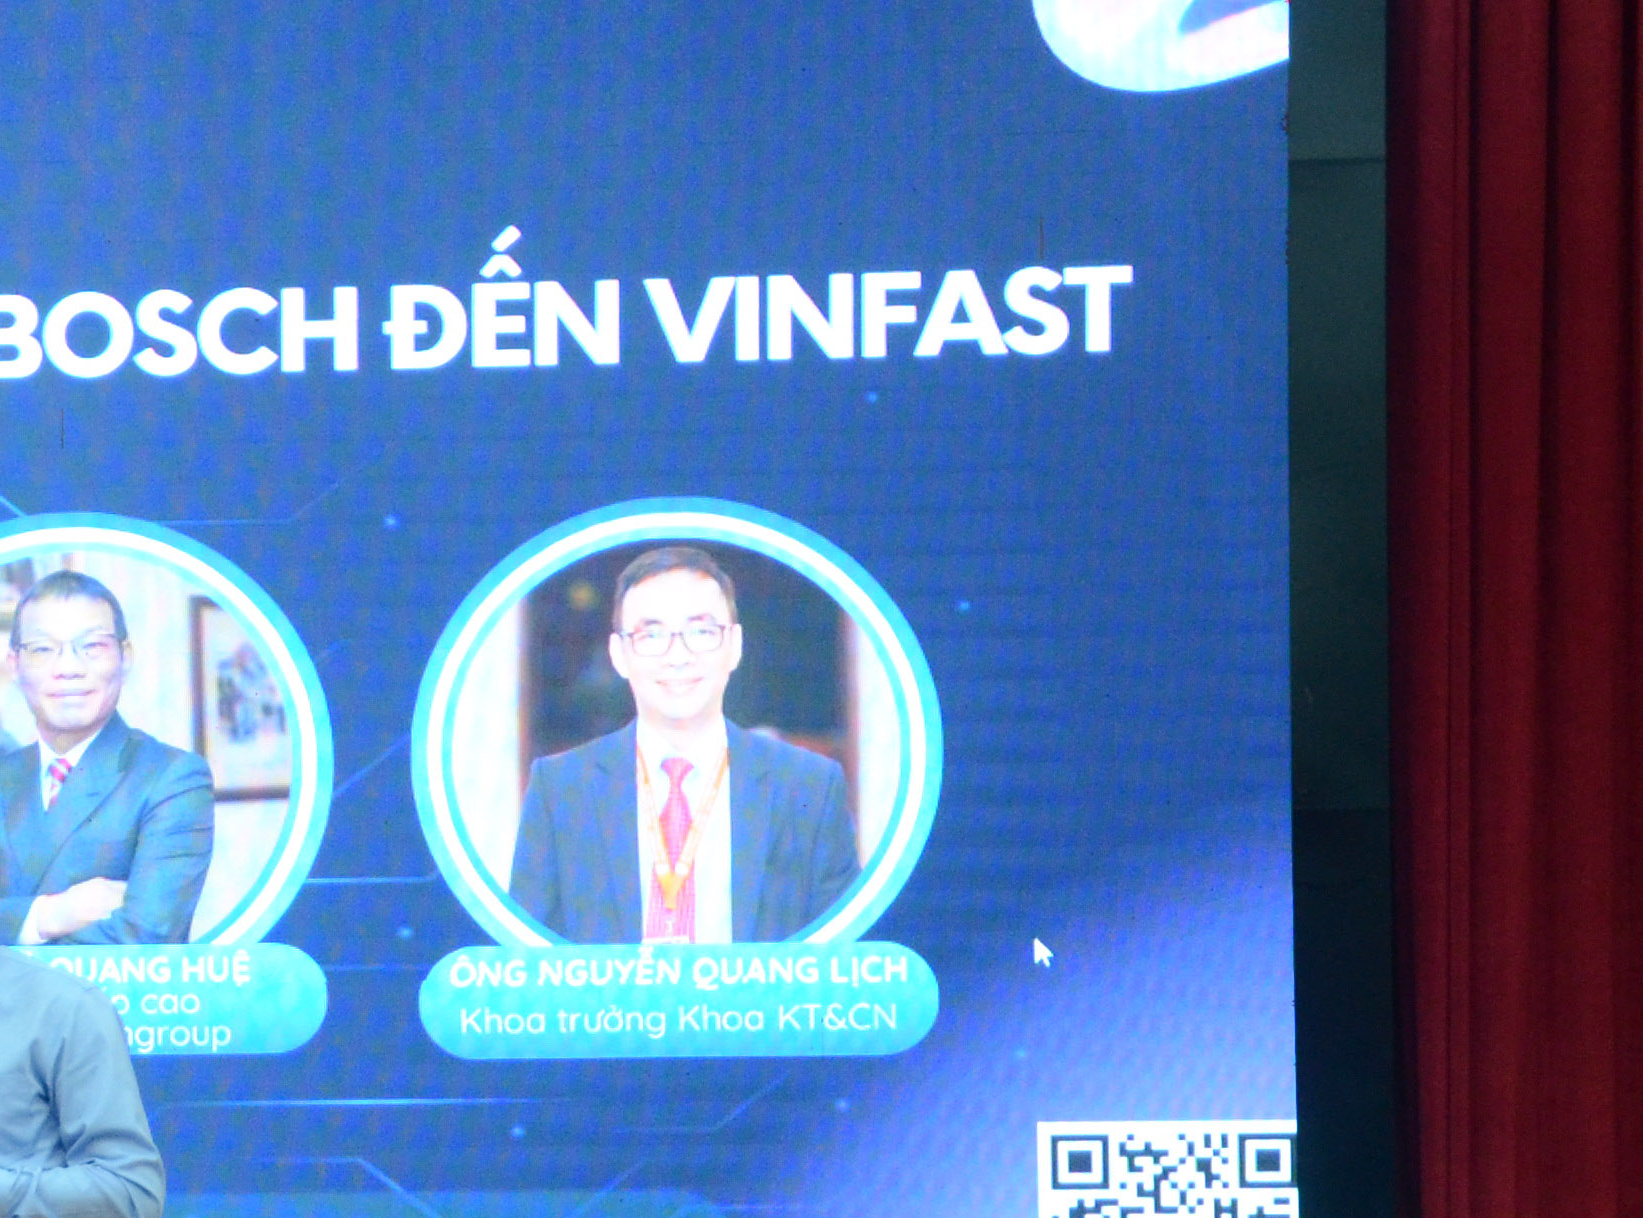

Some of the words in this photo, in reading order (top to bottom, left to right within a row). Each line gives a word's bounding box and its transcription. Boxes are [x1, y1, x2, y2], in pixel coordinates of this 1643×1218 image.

[384, 225, 620, 369] ĐẾN
[645, 265, 1133, 362] VINFAST
[181, 948, 251, 987] HUỆ
[449, 955, 527, 989] ÔNG
[537, 945, 682, 987] NGUYỄN
[692, 956, 818, 991] QUANG
[830, 954, 908, 988] LỊCH
[140, 993, 201, 1015] cao
[460, 1007, 546, 1034] Khoa
[557, 1004, 666, 1039] trưởng
[678, 1004, 764, 1031] Khoa
[778, 1001, 897, 1031] KT&CN
